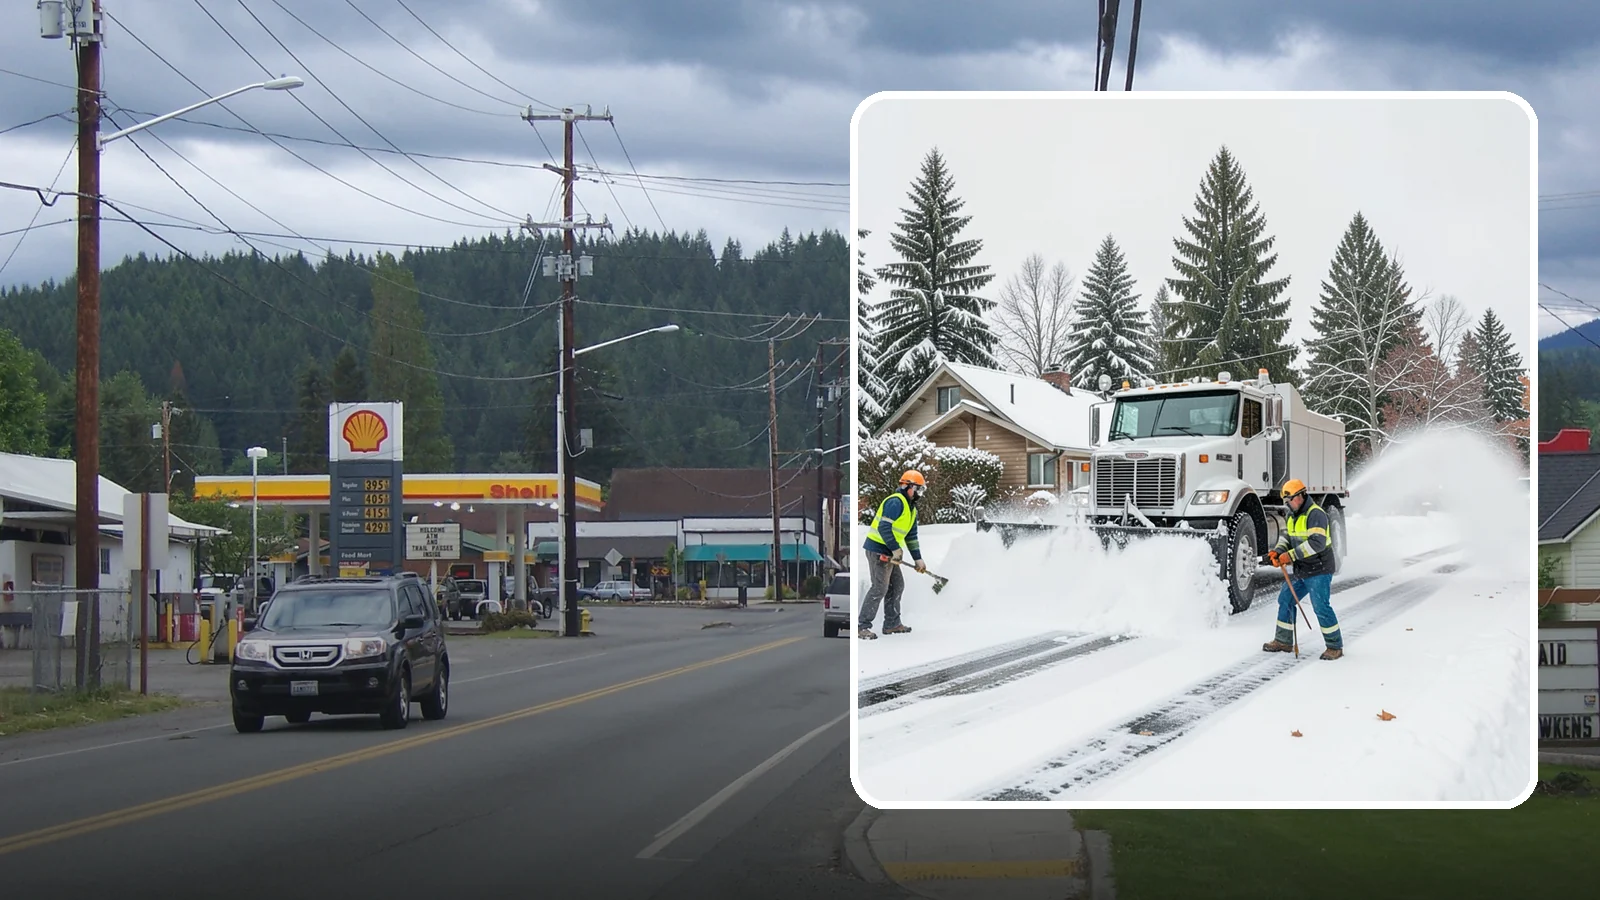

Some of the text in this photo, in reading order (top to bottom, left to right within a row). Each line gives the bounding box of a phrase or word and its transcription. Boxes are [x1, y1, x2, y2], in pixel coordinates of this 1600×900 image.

[366, 480, 384, 490] 395
[490, 484, 547, 499] Shell
[366, 494, 384, 504] 405
[366, 508, 384, 518] 415
[366, 522, 384, 532] 429
[1539, 642, 1567, 665] AID
[1538, 716, 1592, 738] WKENS
